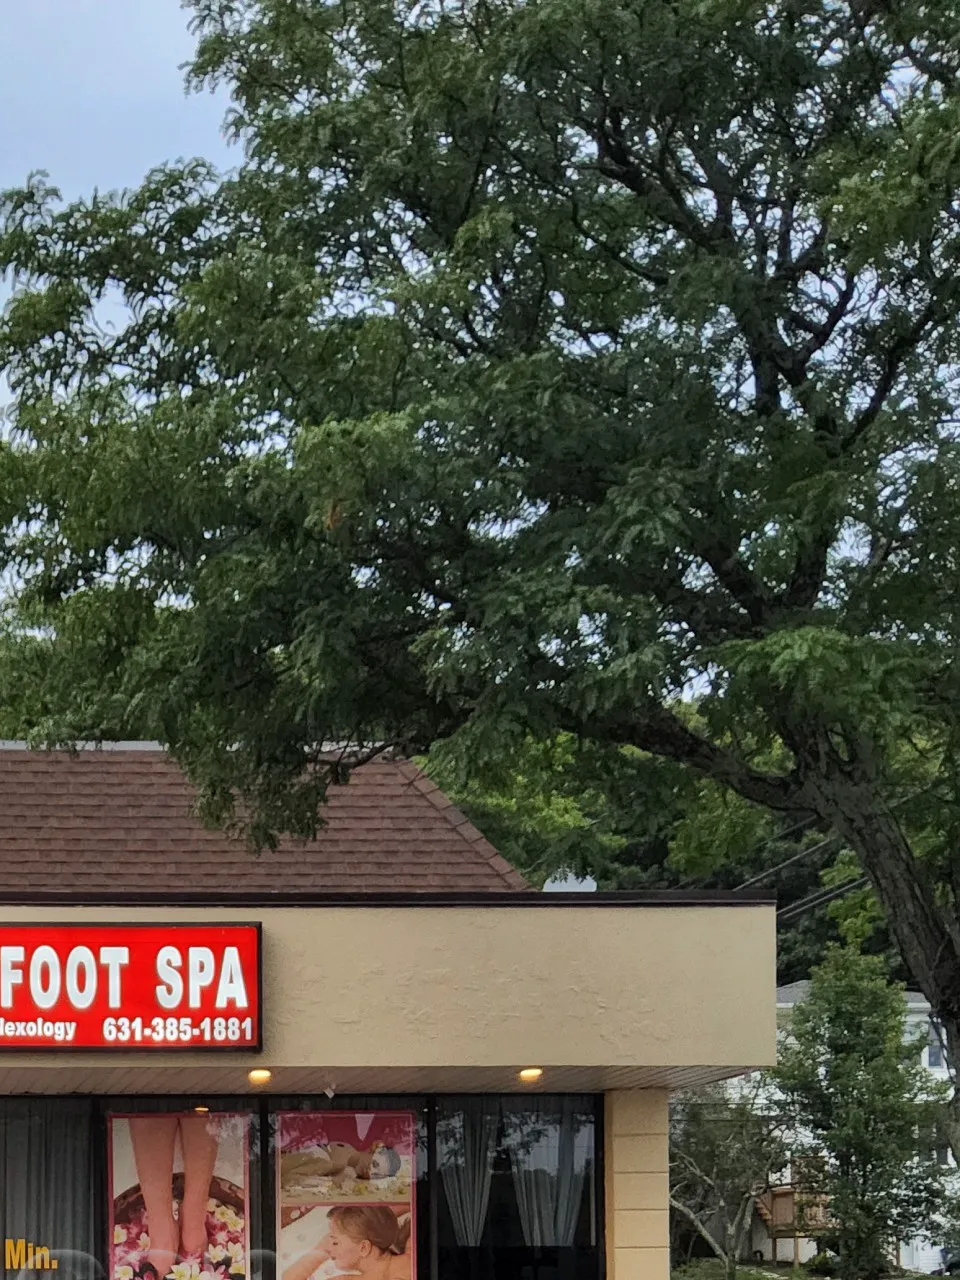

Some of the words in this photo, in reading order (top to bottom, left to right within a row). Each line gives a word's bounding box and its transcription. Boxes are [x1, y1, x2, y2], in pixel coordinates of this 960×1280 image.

[0, 945, 130, 1010] FOOT
[155, 945, 249, 1010] SPA
[102, 1016, 253, 1042] 631-385-1881
[5, 1238, 58, 1271] Min.
